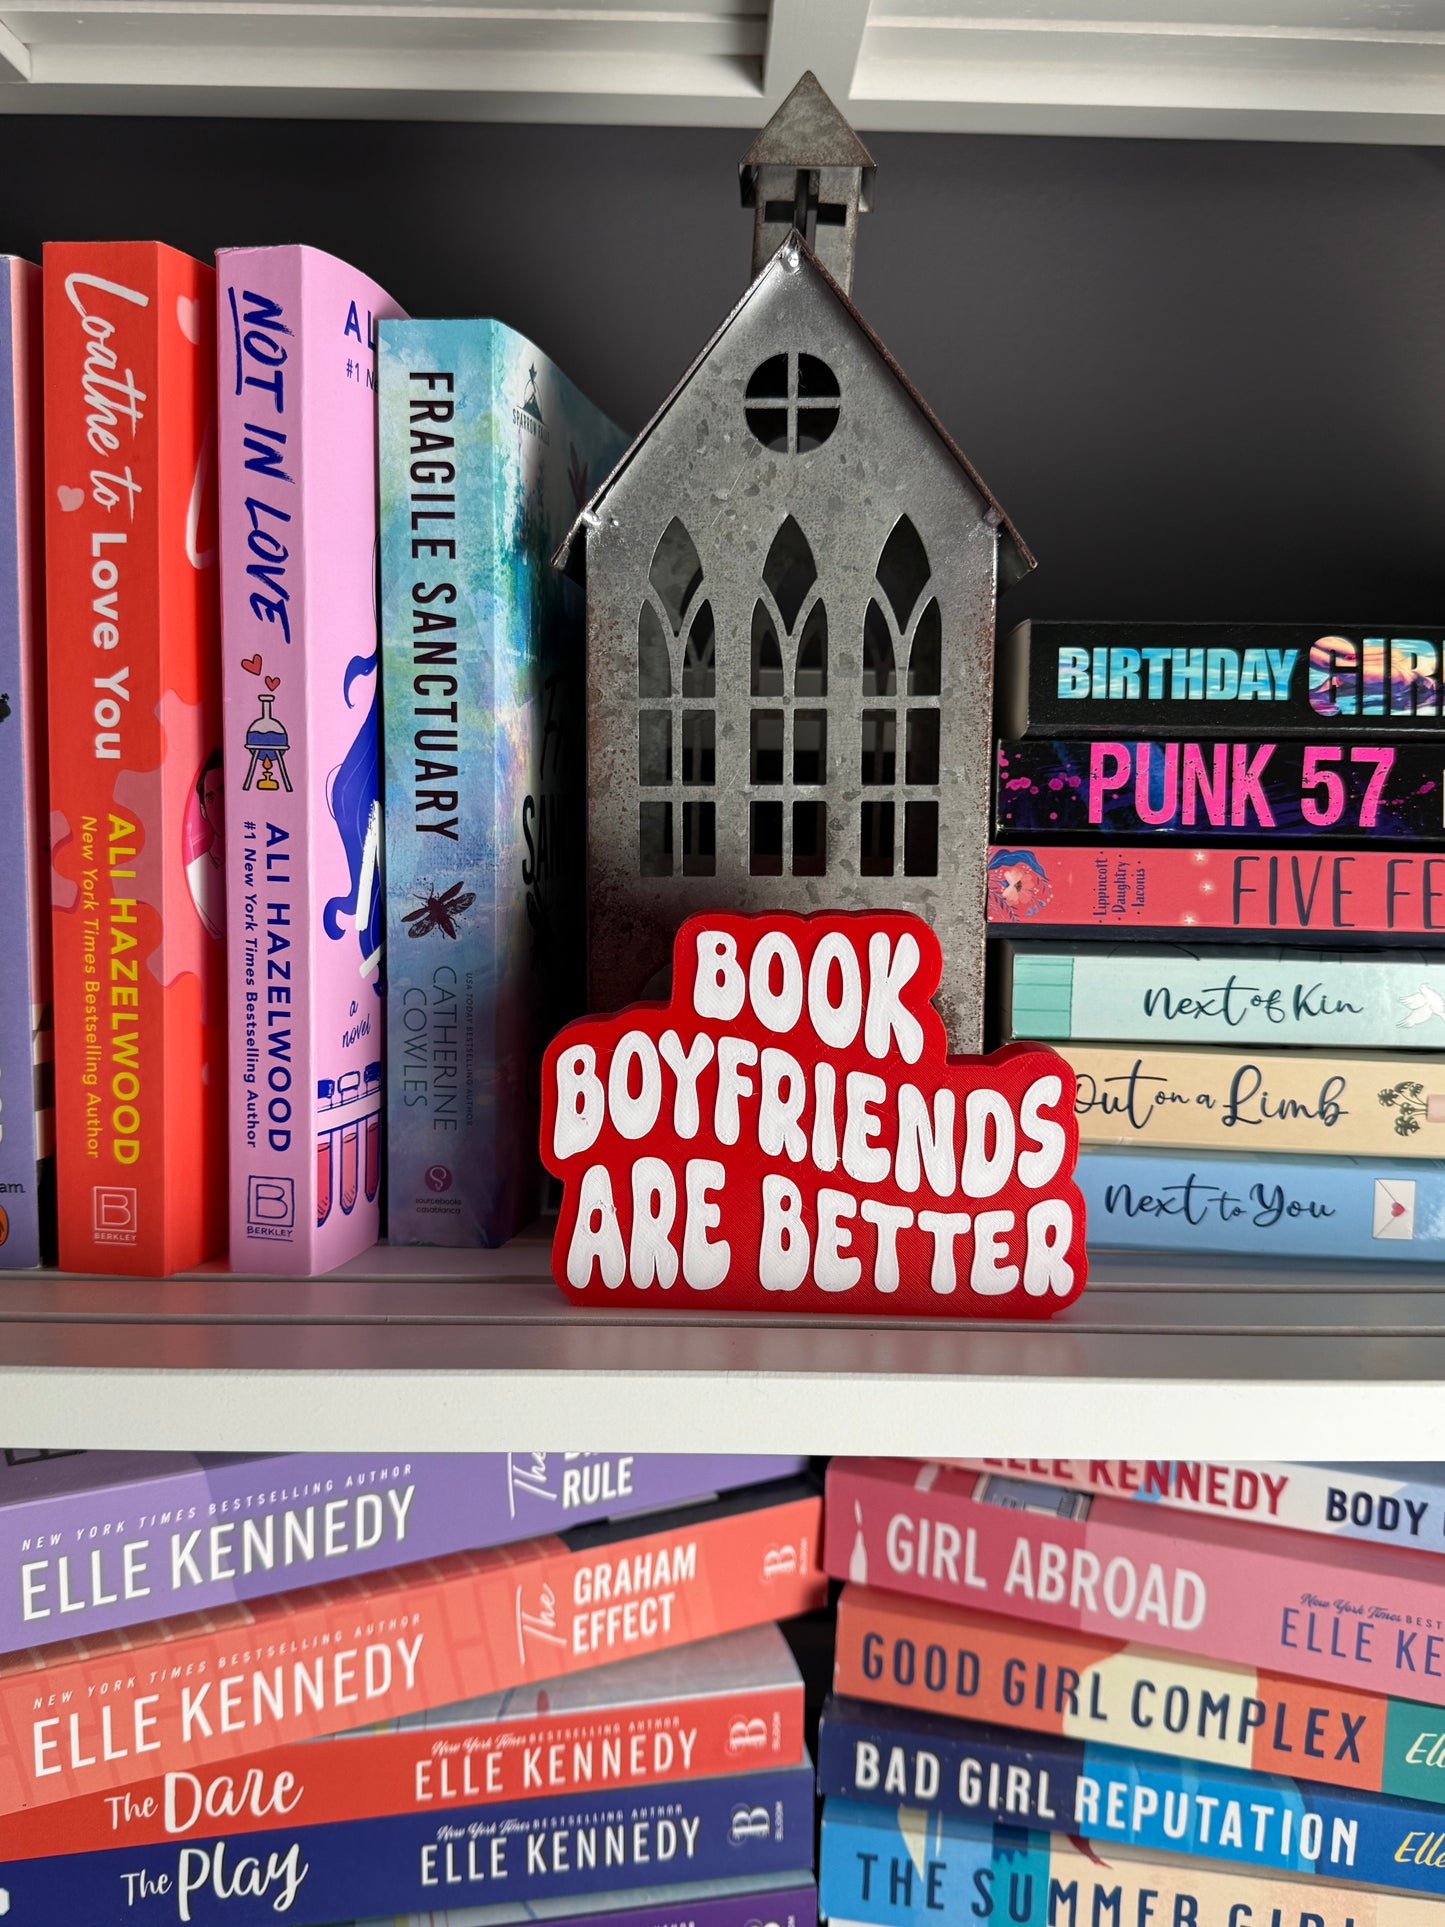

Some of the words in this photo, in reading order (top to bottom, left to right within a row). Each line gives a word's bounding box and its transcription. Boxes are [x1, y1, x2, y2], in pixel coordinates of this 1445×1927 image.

[64, 271, 149, 457] Loathe
[242, 290, 295, 413] NOT
[244, 423, 295, 484] IN
[409, 371, 456, 560] FRAGILE
[92, 466, 142, 524] to
[91, 532, 127, 651] Love
[246, 499, 292, 644] LOVE
[411, 581, 459, 841] SANCTUARY
[1057, 646, 1300, 700] BIRTHDAY
[1308, 636, 1445, 717] GIR
[93, 666, 130, 760] You
[1088, 742, 1277, 828] PUNK
[1300, 746, 1396, 828] 57
[81, 815, 98, 861] New
[108, 813, 137, 878] ALI
[243, 820, 257, 840] #1
[266, 821, 290, 883] ALI
[82, 868, 100, 911] York
[244, 847, 257, 887] New
[1111, 861, 1131, 913] Daughtry
[1233, 855, 1356, 927] FIVE
[83, 918, 100, 974] Times
[244, 893, 258, 931] York
[245, 937, 258, 986] Times
[466, 972, 474, 990] USA
[693, 930, 924, 1064] BOOK
[82, 980, 102, 1086] Bestselling
[110, 898, 140, 1165] HAZELWOOD
[266, 902, 292, 1152] HAZELWOOD
[342, 1013, 371, 1048] novel
[349, 1000, 359, 1017] a
[466, 992, 474, 1024] TODAY
[1143, 975, 1260, 1026] Next
[1251, 989, 1286, 1023] of
[1294, 982, 1364, 1022] Kin
[244, 991, 259, 1083] Bestselling
[403, 987, 428, 1107] COWLES
[433, 966, 457, 1131] CATHERINE
[465, 1026, 474, 1088] BESTSELLING
[86, 1092, 104, 1159] Author
[246, 1089, 260, 1148] Author
[465, 1090, 474, 1127] AUTHOR
[553, 1029, 1066, 1198] BOYFRIENDS
[1073, 1059, 1169, 1130] Out
[1154, 1088, 1190, 1106] on
[1195, 1093, 1216, 1110] a
[1221, 1064, 1349, 1127] Limb
[246, 1225, 294, 1238] BERKLEY
[566, 1157, 731, 1290] ARE
[758, 1174, 1074, 1297] BETTER
[1104, 1173, 1220, 1226] Next
[1208, 1193, 1247, 1222] to
[1249, 1182, 1336, 1228] You
[94, 1232, 137, 1242] BERKLEY
[21, 1532, 63, 1552] NEW
[76, 1519, 127, 1542] YORK
[139, 1507, 198, 1529] TIMES
[208, 1479, 335, 1516] BESTSELLING
[345, 1463, 413, 1489] AUTHOR
[562, 1455, 634, 1511] RULE
[1088, 1460, 1290, 1516] KENNEDY
[1325, 1486, 1430, 1536] BODY
[22, 1539, 151, 1622] ELLE
[171, 1485, 416, 1591] KENNEDY
[573, 1541, 697, 1607] GRAHAM
[885, 1513, 988, 1590] GIRL
[1003, 1536, 1207, 1632] ABROAD
[515, 1582, 568, 1667] The
[572, 1593, 676, 1656] EFFECT
[1280, 1606, 1375, 1663] ELLE
[1300, 1593, 1330, 1608] New
[1333, 1598, 1365, 1615] York
[1367, 1606, 1402, 1622] Times
[33, 1690, 74, 1710] NEW
[87, 1676, 137, 1697] YORK
[149, 1662, 207, 1684] TIMES
[218, 1631, 343, 1669] BESTSELLING
[354, 1612, 421, 1640] AUTHOR
[33, 1693, 162, 1778] ELLE
[180, 1633, 424, 1743] KENNEDY
[861, 1631, 981, 1697] GOOD
[1003, 1657, 1108, 1722] GIRL
[1130, 1680, 1368, 1764] COMPLEX
[415, 1752, 504, 1802] ELLE
[523, 1728, 697, 1789] KENNEDY
[431, 1741, 460, 1757] New
[462, 1737, 492, 1754] York
[495, 1733, 527, 1750] Times
[529, 1722, 621, 1745] BESTSELLING
[628, 1716, 681, 1733] AUTHOR
[103, 1792, 159, 1830] The
[164, 1768, 304, 1834] Dare
[437, 1824, 465, 1841] New
[467, 1821, 497, 1840] York
[499, 1817, 530, 1835] Times
[532, 1810, 623, 1831] BESTSELLING
[631, 1804, 683, 1819] AUTHOR
[855, 1740, 940, 1799] BAD
[957, 1756, 1057, 1821] GIRL
[1074, 1775, 1359, 1867] REPUTATION
[119, 1869, 173, 1906] The
[178, 1841, 309, 1922] Play
[420, 1837, 509, 1887] ELLE
[527, 1816, 700, 1875] KENNEDY
[857, 1851, 947, 1911] THE
[970, 1867, 1199, 1927] SUMMER
